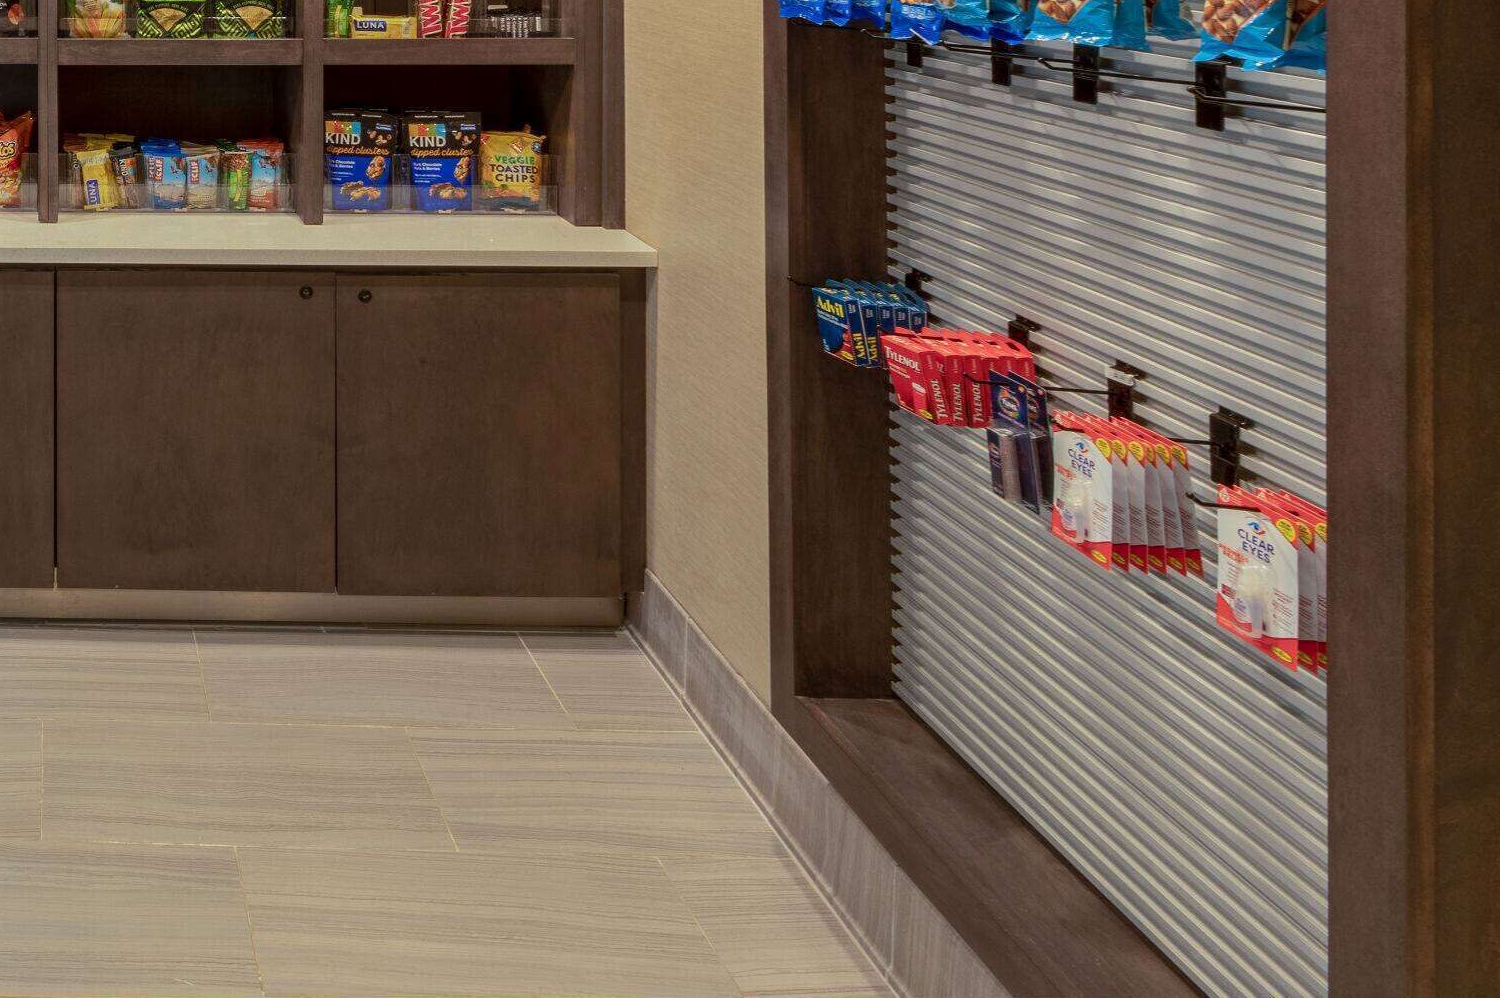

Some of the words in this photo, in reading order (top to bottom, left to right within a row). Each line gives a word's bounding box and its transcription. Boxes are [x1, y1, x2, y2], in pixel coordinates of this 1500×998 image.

[357, 20, 386, 30] LUNA
[325, 133, 362, 146] KIND
[410, 135, 447, 148] KIND
[489, 164, 539, 175] TOASTED
[494, 155, 536, 165] VEGGIE
[494, 174, 536, 184] CHIPS
[816, 296, 845, 318] Advil
[884, 345, 921, 372] TYLENOL
[930, 378, 949, 419] TYLENOL
[952, 383, 964, 421] TYLENOL
[971, 382, 985, 422] TYLENOL
[1068, 447, 1096, 472] CLEAR
[1071, 459, 1093, 479] EYES
[1237, 528, 1275, 554] CLEAR
[1242, 542, 1271, 564] EYES
